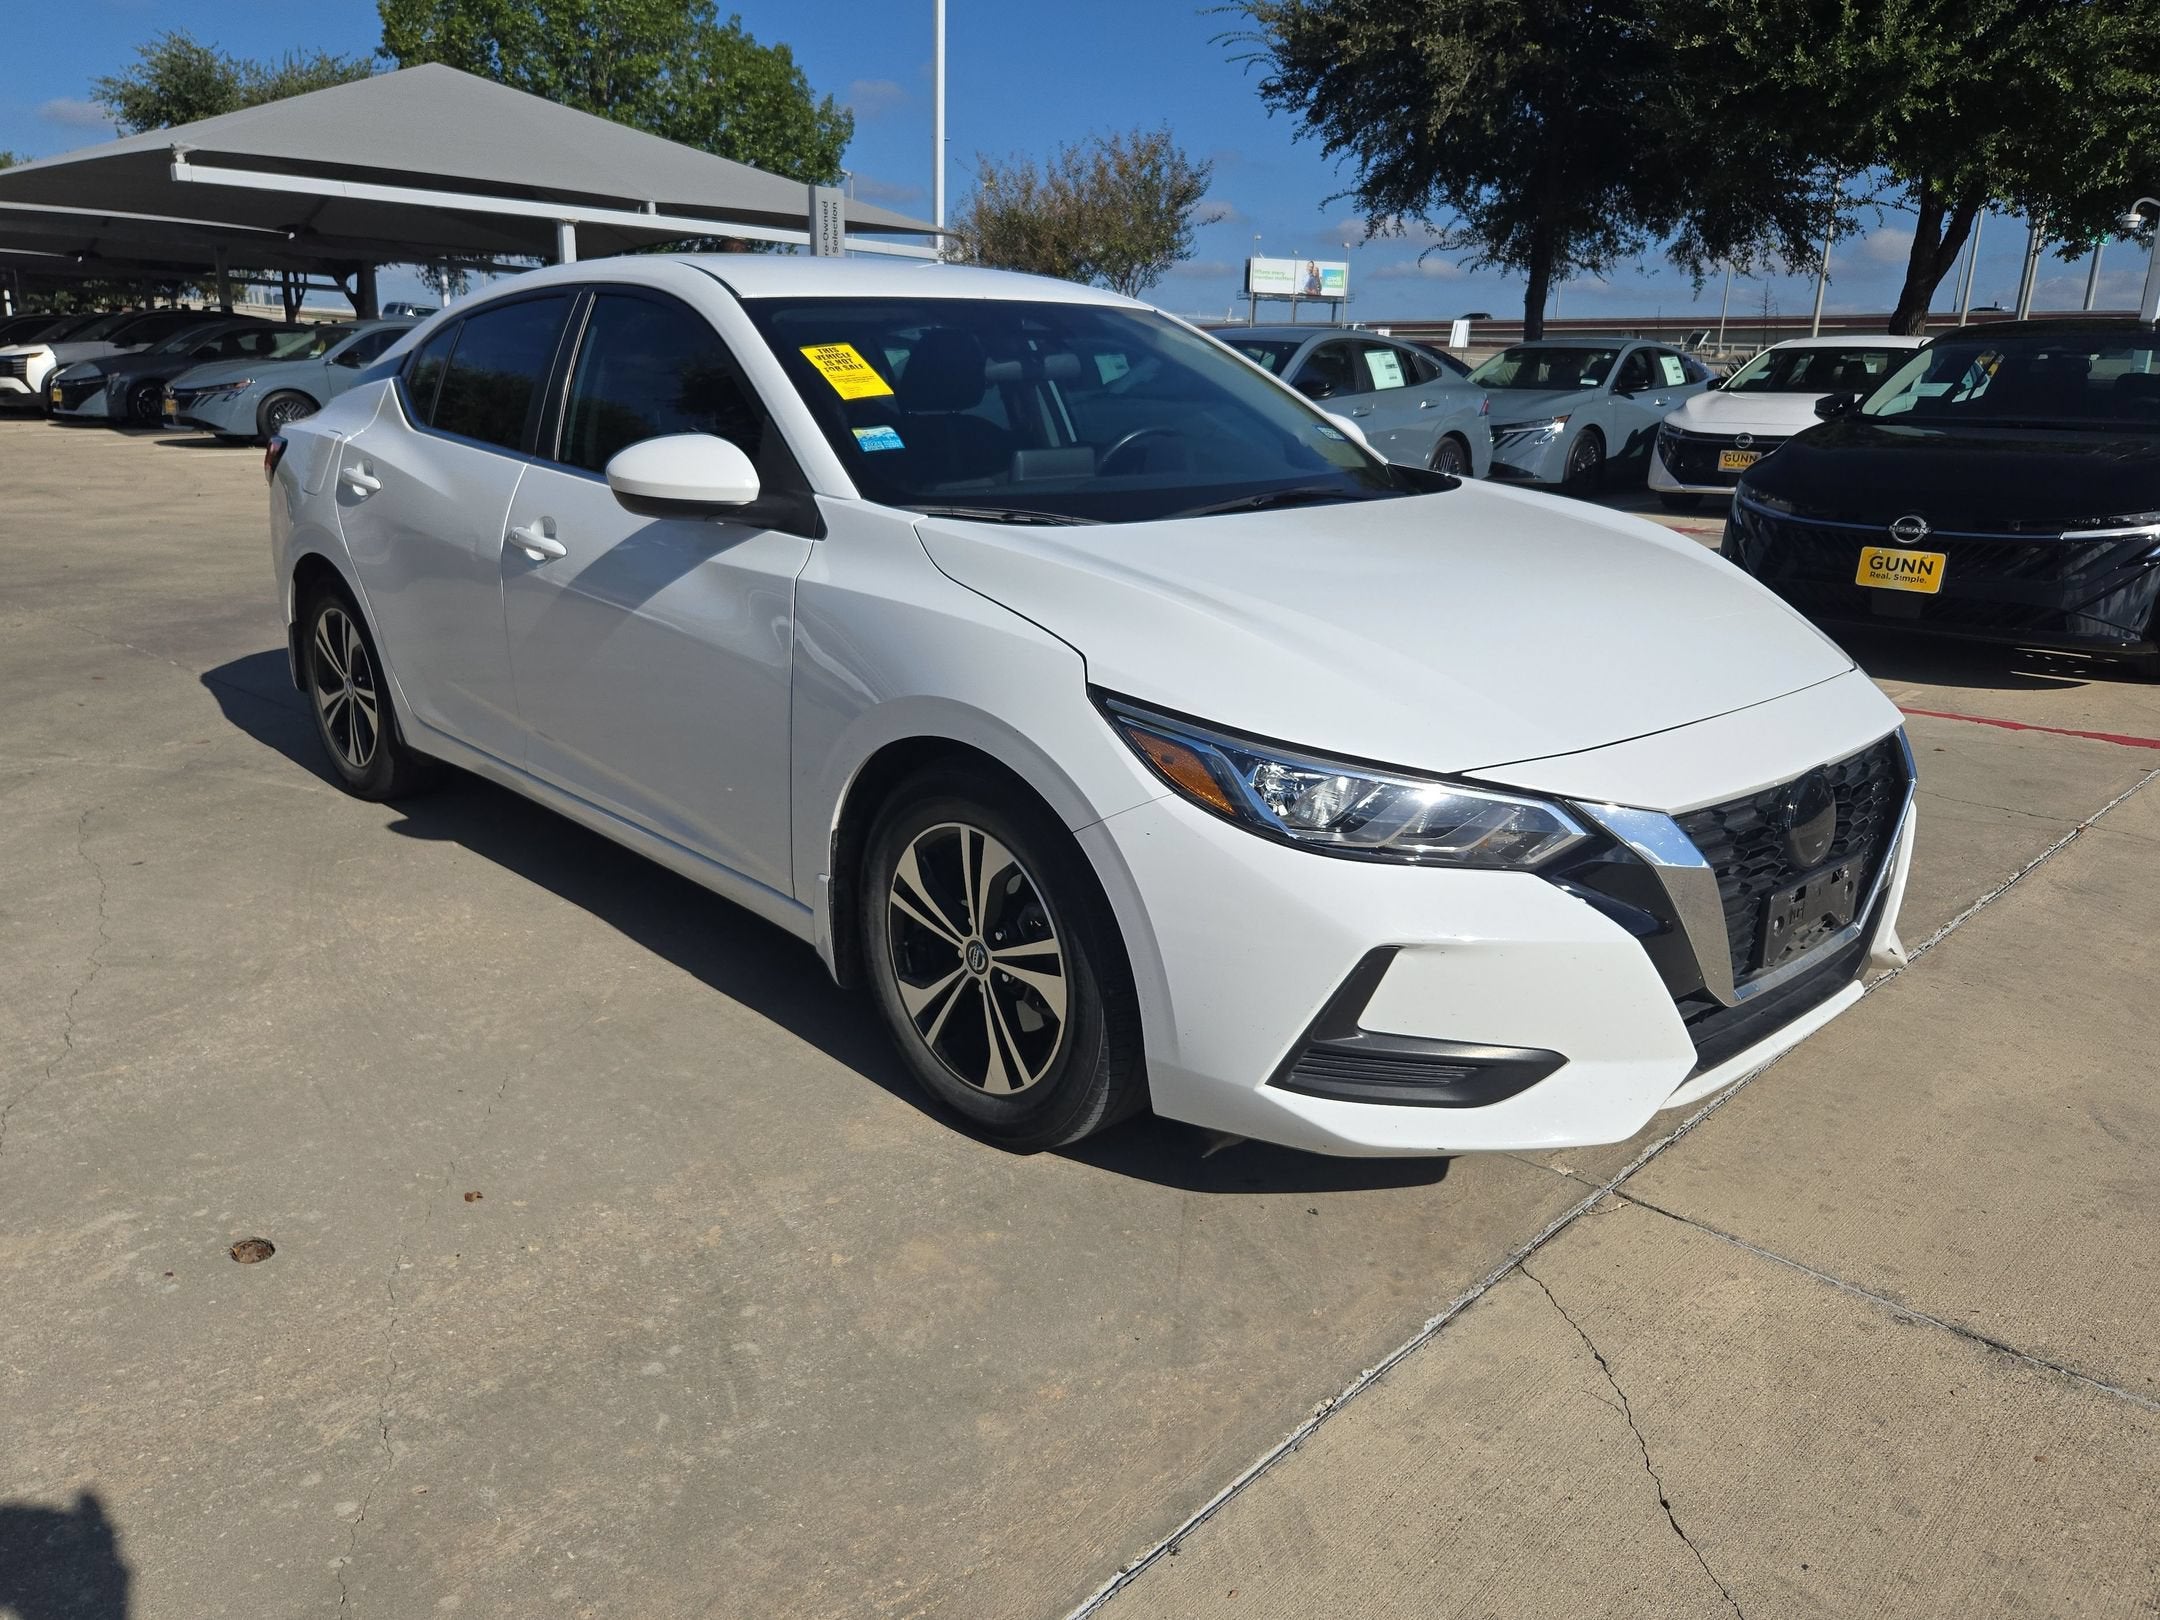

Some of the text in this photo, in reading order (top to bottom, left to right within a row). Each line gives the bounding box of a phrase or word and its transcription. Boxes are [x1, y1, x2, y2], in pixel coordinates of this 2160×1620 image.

[815, 353, 851, 361] VEHICLE
[1724, 454, 1757, 463] GUNN
[1889, 525, 1928, 535] NISSAN
[1869, 555, 1934, 576] GUNN
[1869, 571, 1927, 584] Real. Simple.
